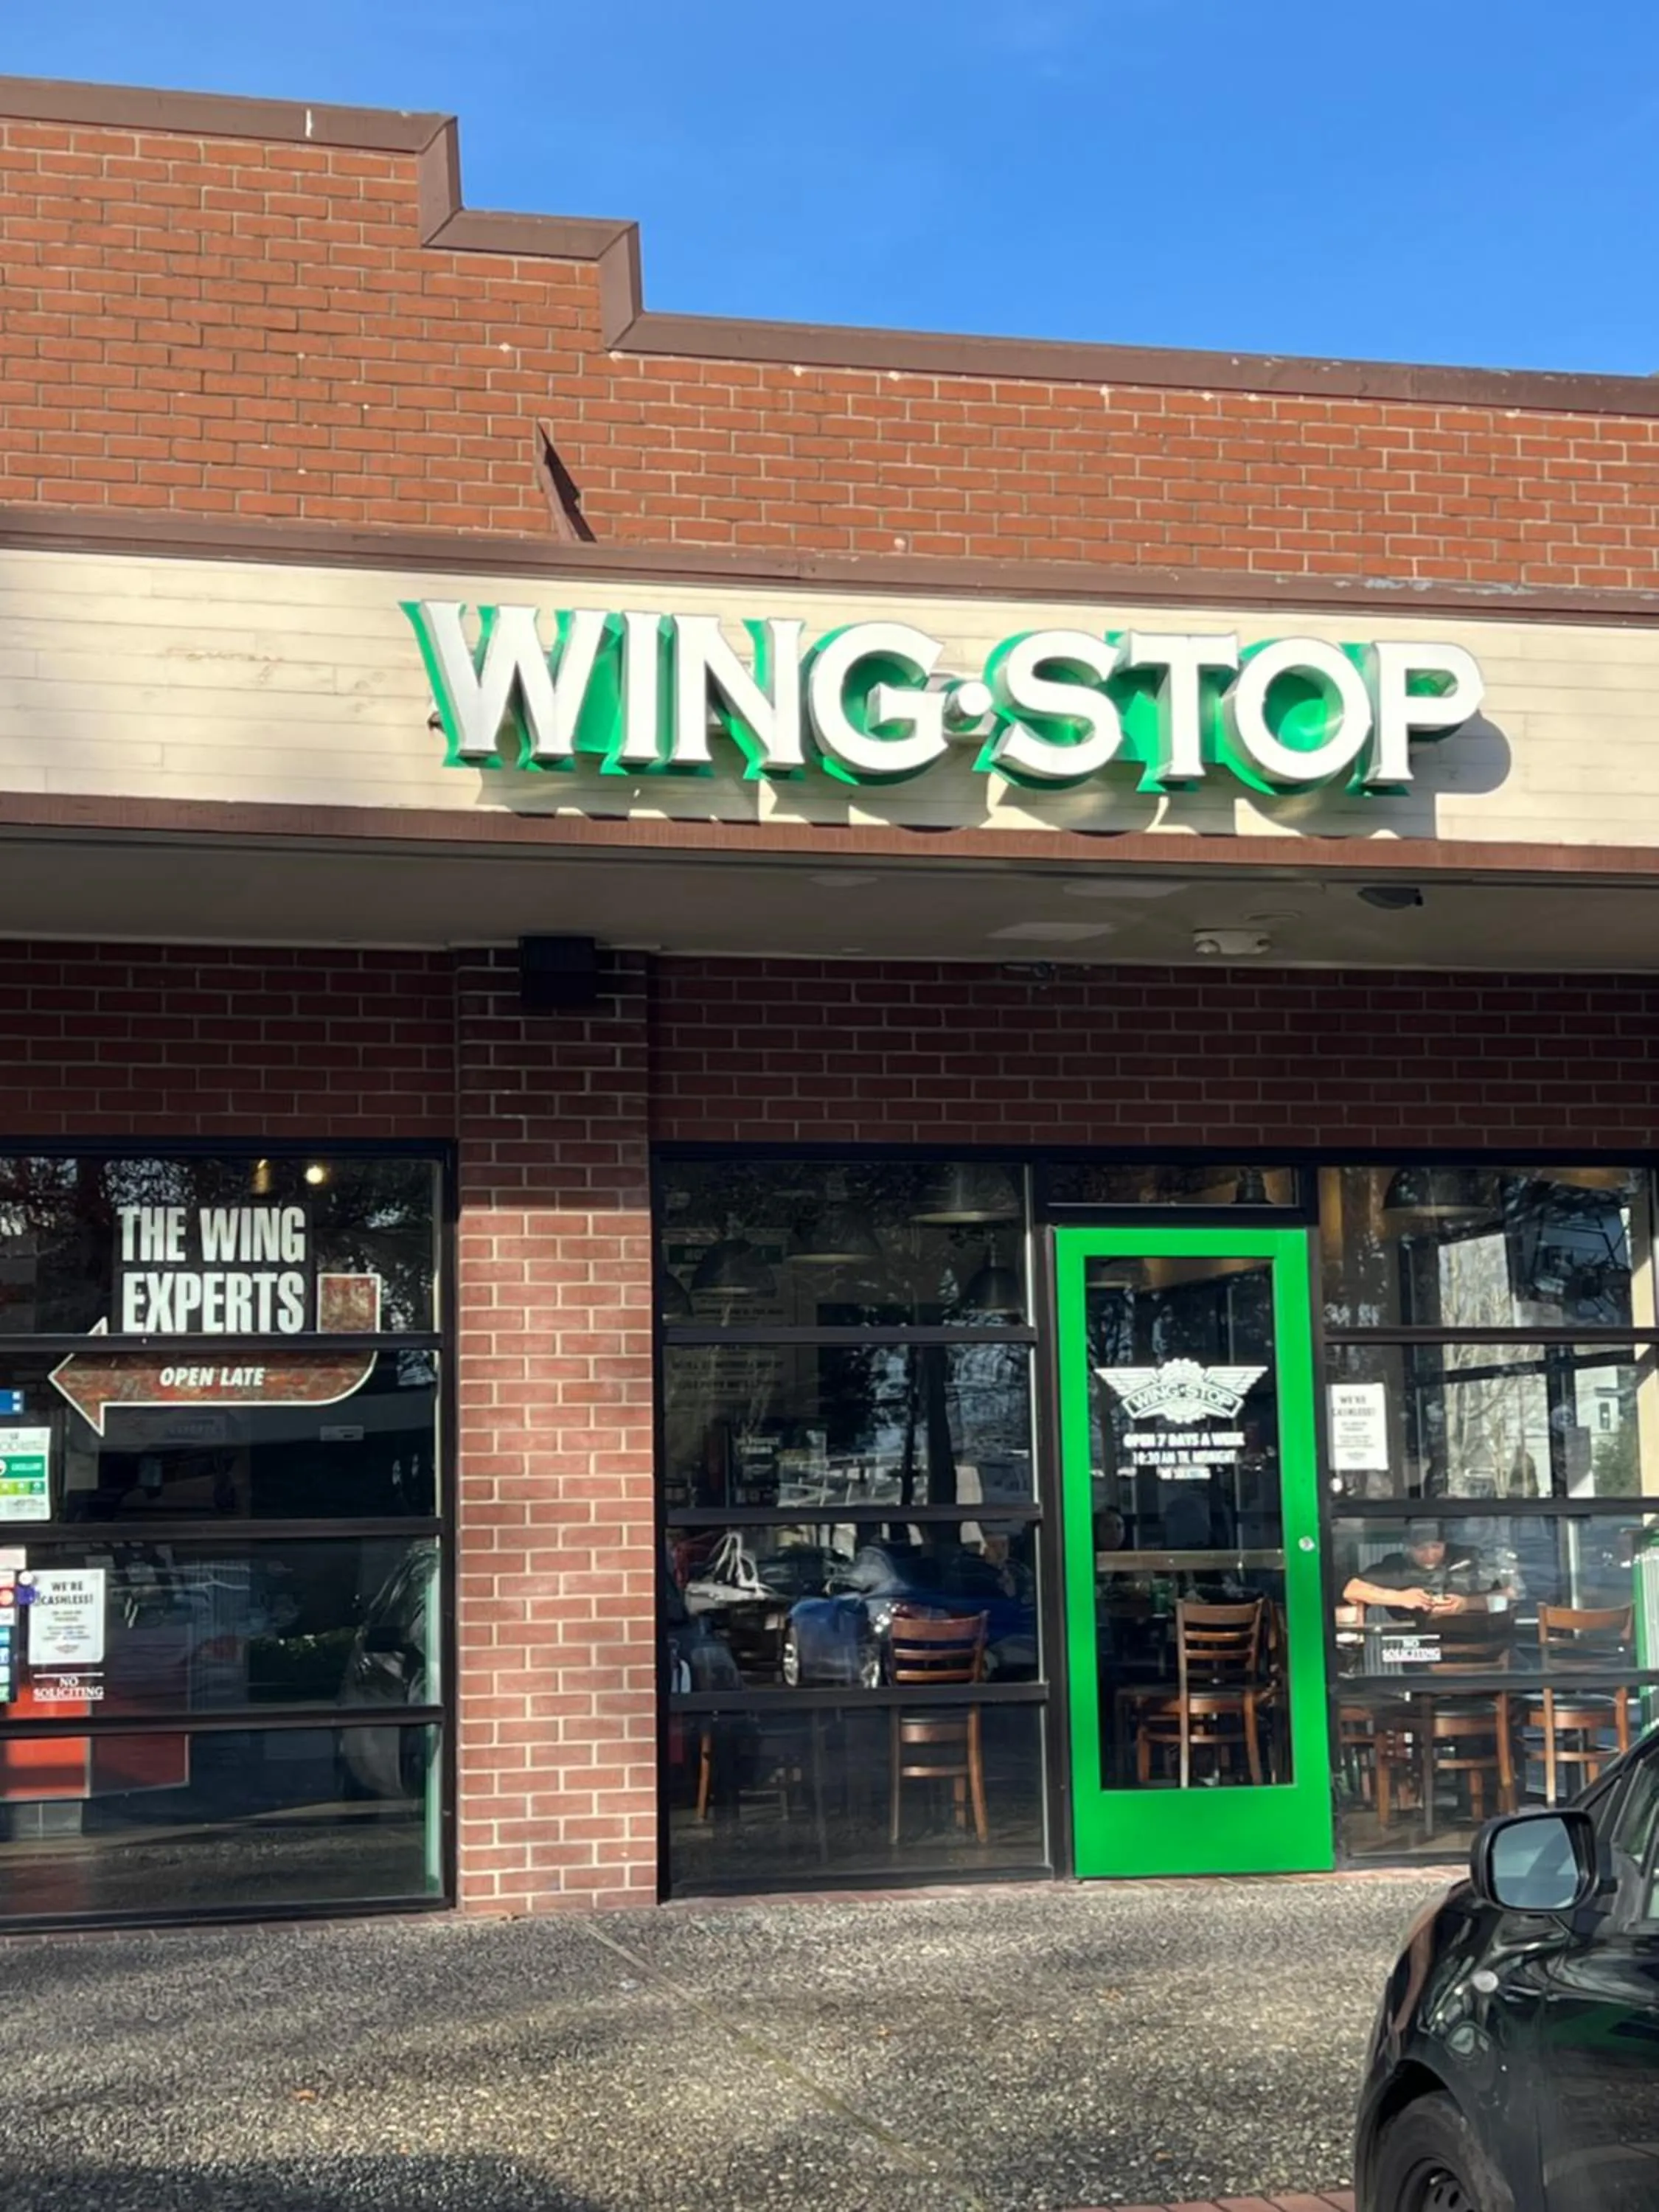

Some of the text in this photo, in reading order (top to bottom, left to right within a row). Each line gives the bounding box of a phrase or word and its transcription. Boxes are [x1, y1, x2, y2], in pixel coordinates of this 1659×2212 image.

[116, 1206, 305, 1263] THE WING
[122, 1271, 305, 1334] EXPERTS
[159, 1367, 266, 1386] OPEN LATE
[51, 1581, 83, 1591] WE'RE
[41, 1595, 93, 1605] CASHLESS!
[59, 1677, 78, 1687] NO
[33, 1687, 103, 1699] SOLICITING
